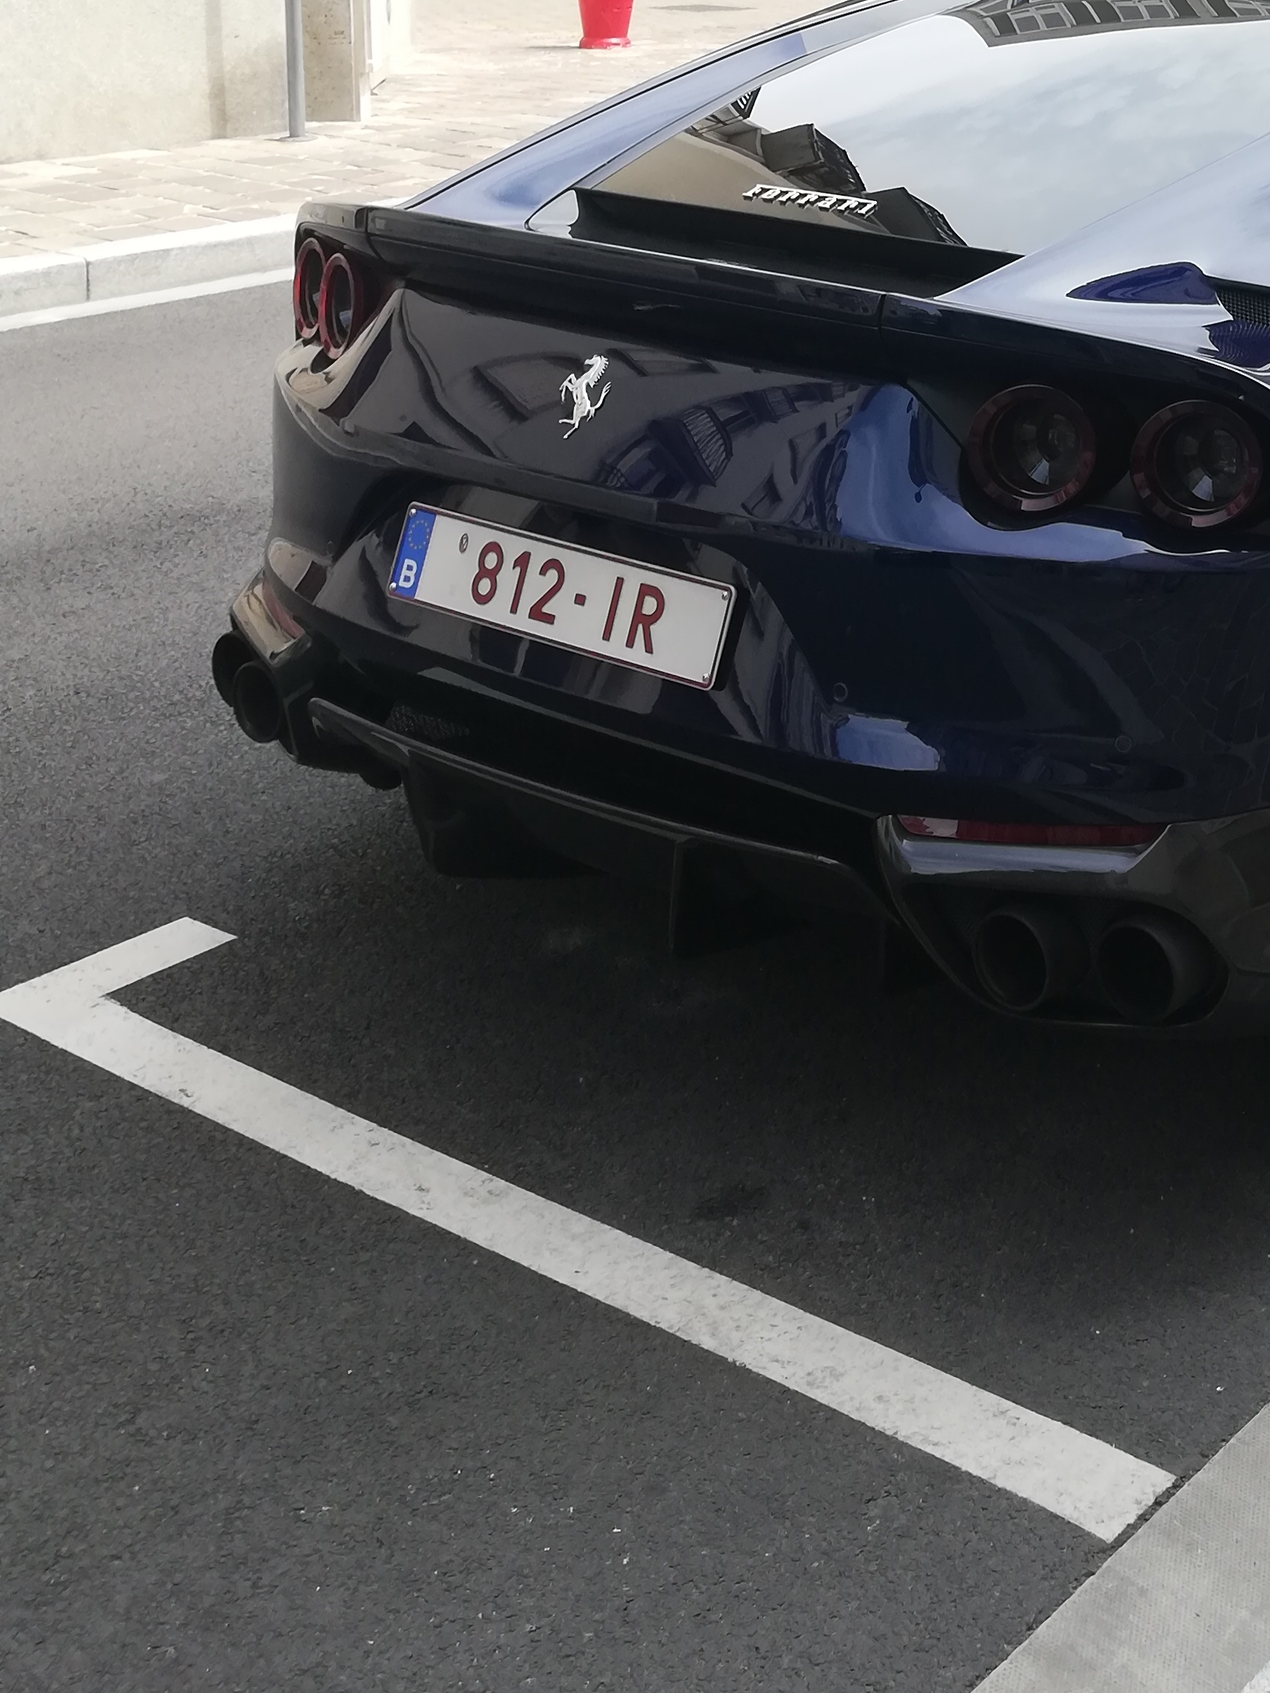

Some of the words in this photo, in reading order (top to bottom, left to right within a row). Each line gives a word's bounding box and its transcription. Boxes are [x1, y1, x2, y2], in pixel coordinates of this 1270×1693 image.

[742, 183, 878, 218] Ferrari
[398, 558, 418, 589] B
[471, 541, 666, 654] 812-IR
